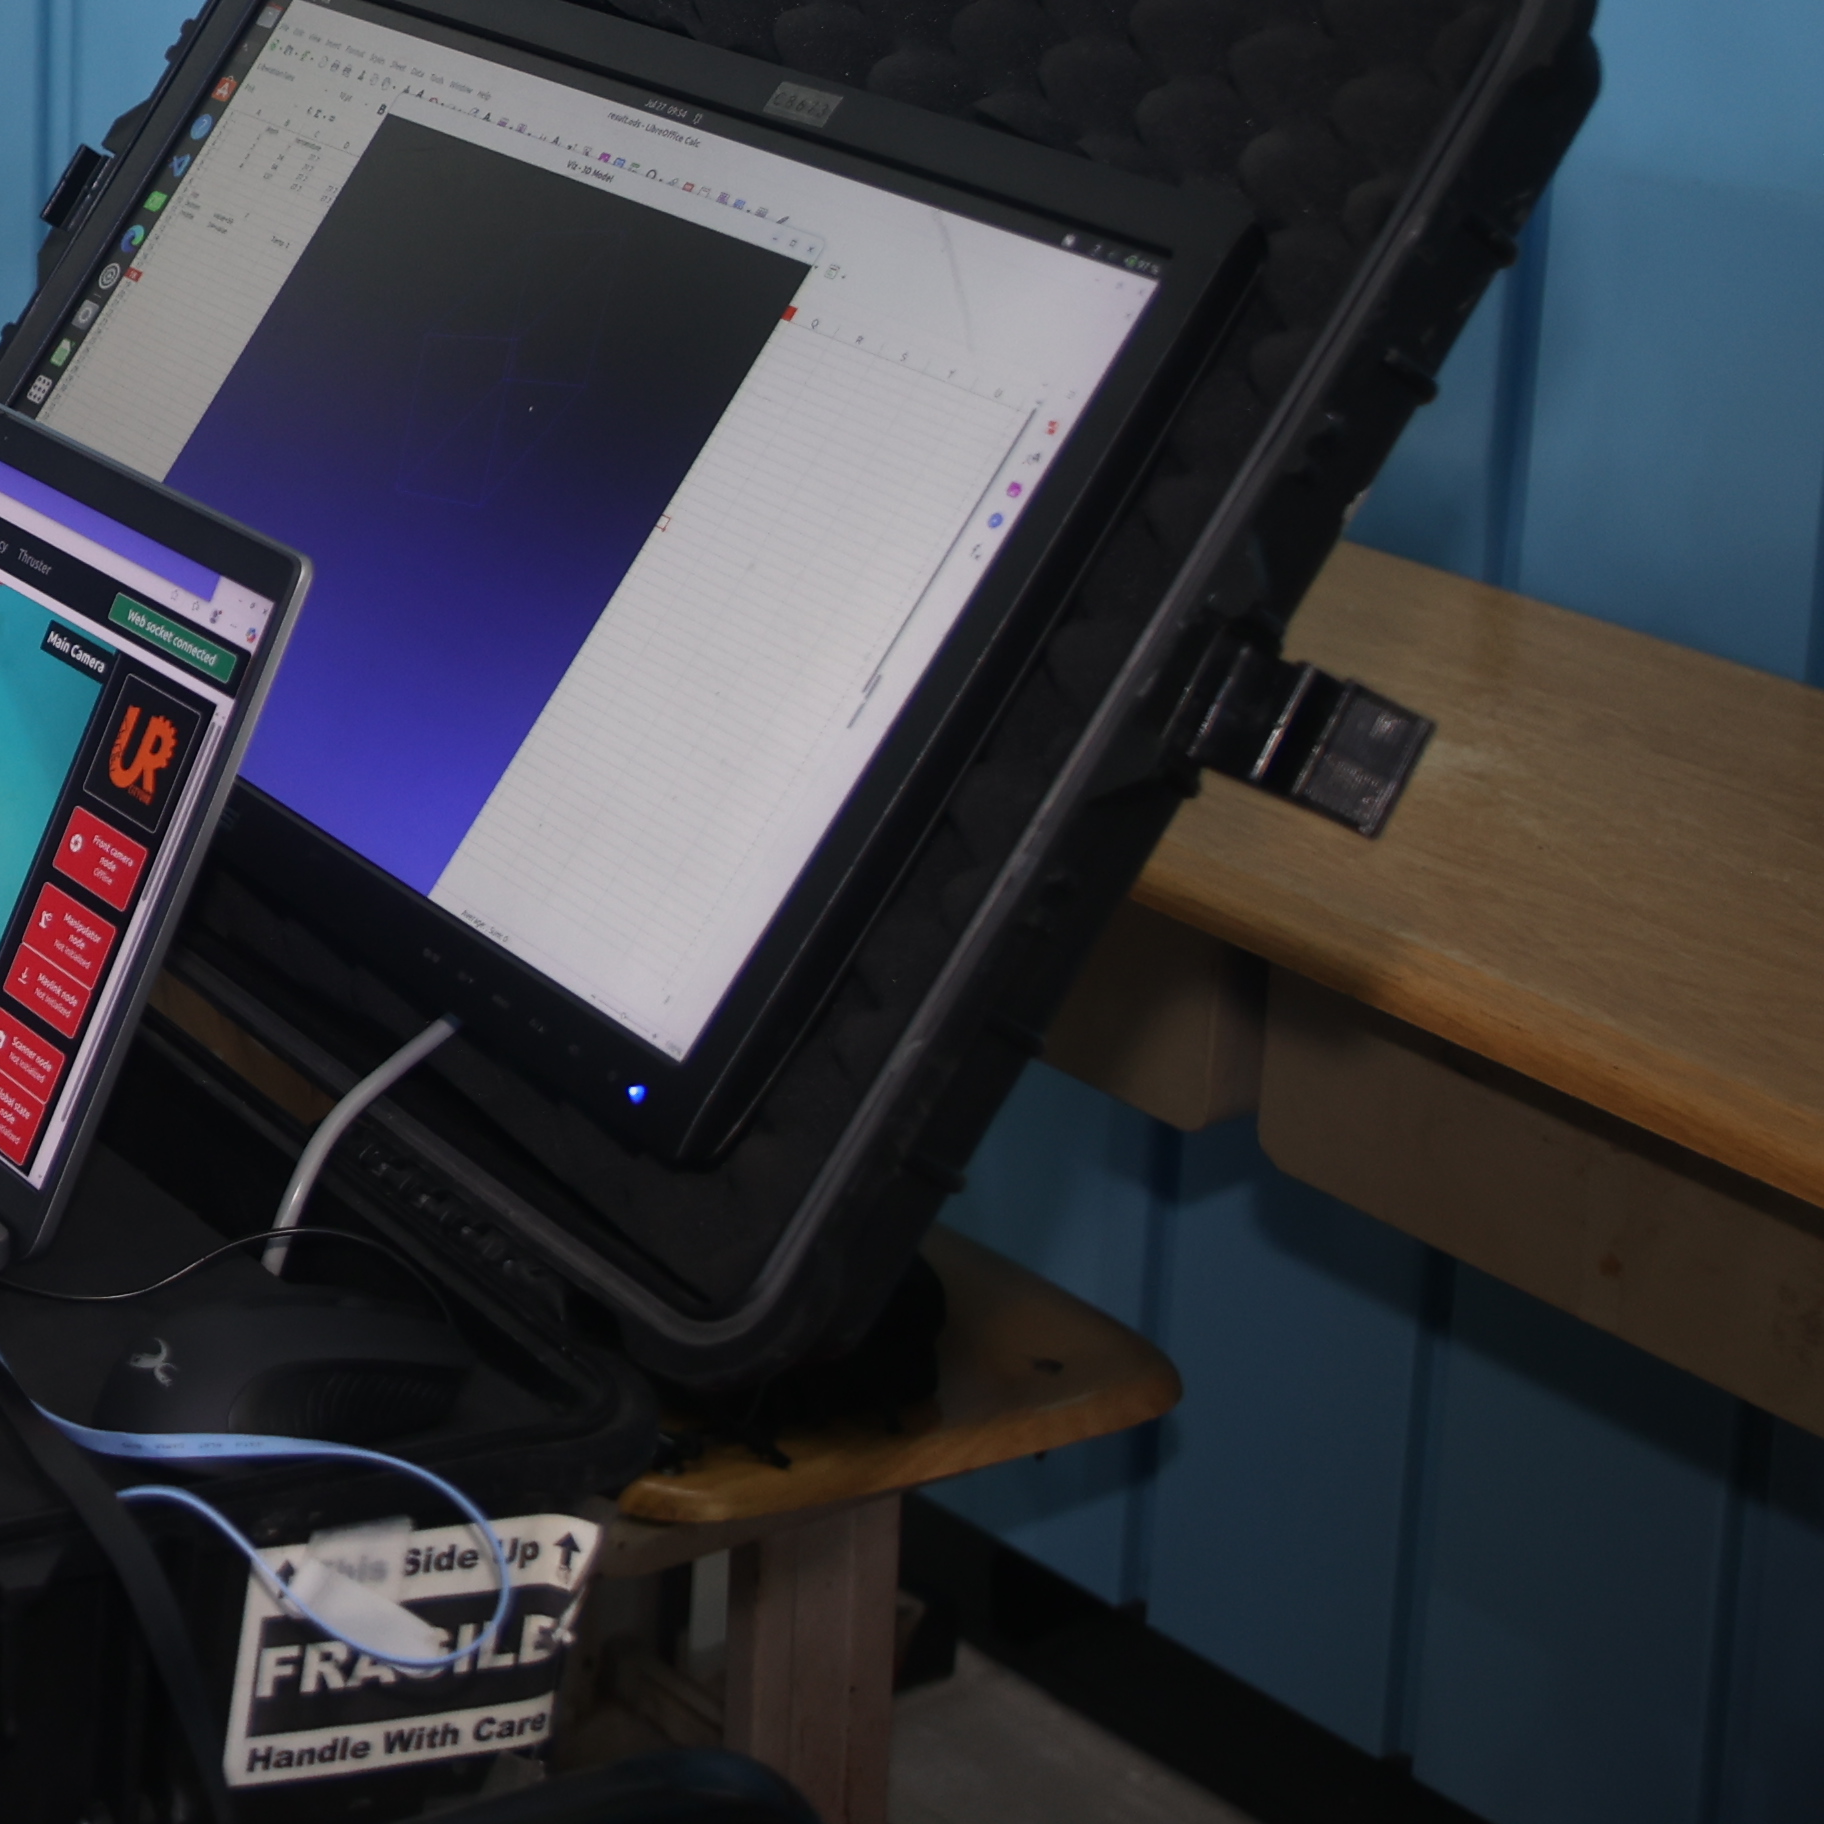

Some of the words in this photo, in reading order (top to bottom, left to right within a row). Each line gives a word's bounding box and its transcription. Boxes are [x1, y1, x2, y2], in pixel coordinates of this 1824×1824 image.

[645, 122, 685, 145] LibreOffice
[684, 134, 702, 150] Calc
[592, 168, 615, 184] Model
[17, 547, 53, 576] Thruster
[46, 630, 72, 654] Main
[69, 643, 106, 674] Camera
[127, 607, 147, 629] Web
[145, 619, 175, 645] socket
[172, 633, 219, 668] connected
[92, 834, 112, 854] Front
[109, 846, 135, 868] camera
[99, 856, 118, 873] node
[63, 912, 102, 945] Manipulator
[68, 933, 87, 950] node
[53, 938, 66, 953] Not
[34, 987, 47, 1001] Not
[37, 972, 64, 996] Mavlink
[61, 991, 79, 1008] node
[8, 1051, 21, 1066] Not
[11, 1035, 38, 1059] Scanner
[35, 1053, 53, 1073] node
[11, 1101, 32, 1121] state
[404, 1543, 479, 1577] Side
[493, 1537, 541, 1571] Up
[247, 1737, 371, 1774] Handle
[382, 1724, 460, 1756] With
[472, 1709, 547, 1743] Care
